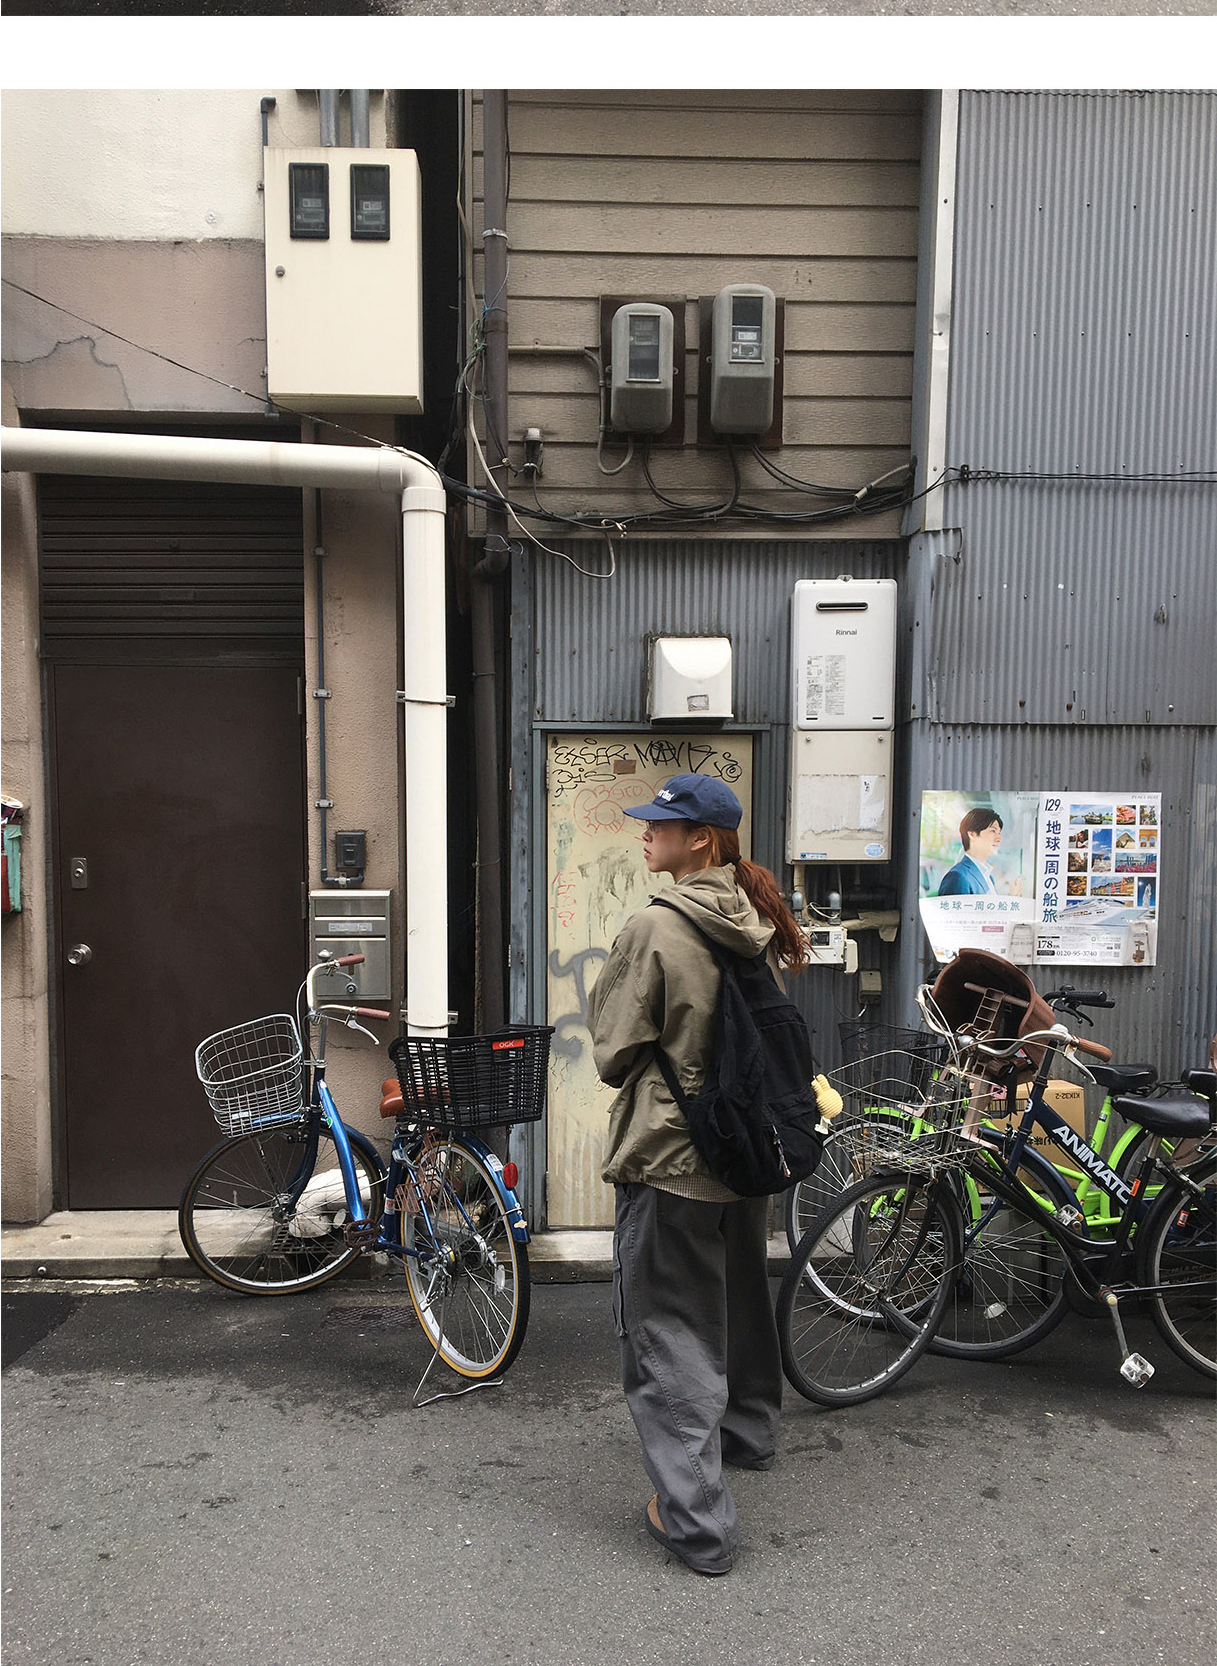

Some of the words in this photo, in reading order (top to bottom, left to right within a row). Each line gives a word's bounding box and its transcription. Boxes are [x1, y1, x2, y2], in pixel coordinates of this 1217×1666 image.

[1044, 799, 1061, 811] 129
[1042, 820, 1061, 923] 地球一周の船旅
[940, 900, 1020, 911] 地球一周の船旅
[1037, 940, 1053, 949] 178
